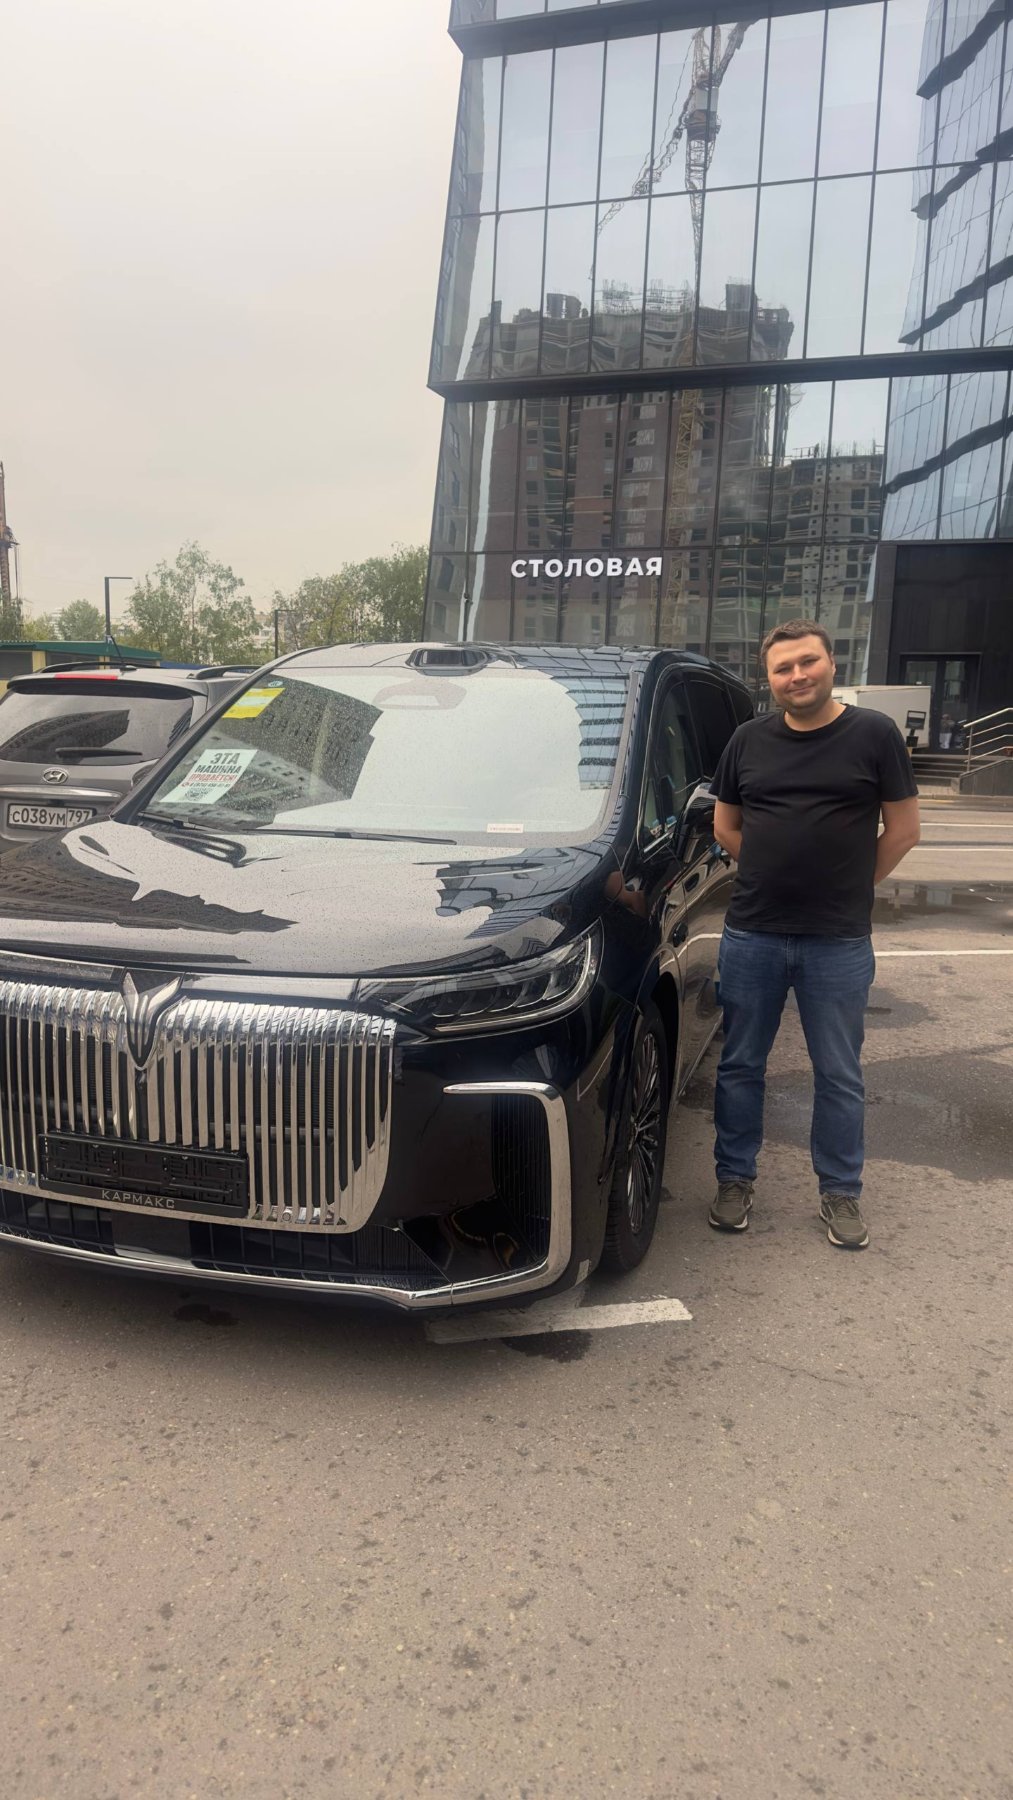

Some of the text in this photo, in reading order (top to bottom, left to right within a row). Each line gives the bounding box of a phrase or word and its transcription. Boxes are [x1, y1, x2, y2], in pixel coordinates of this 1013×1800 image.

[510, 556, 663, 578] СТОЛОВАЯ
[210, 752, 241, 765] ЭТА
[194, 764, 243, 774] МАШИНА
[101, 1189, 176, 1209] КАРМАКС
